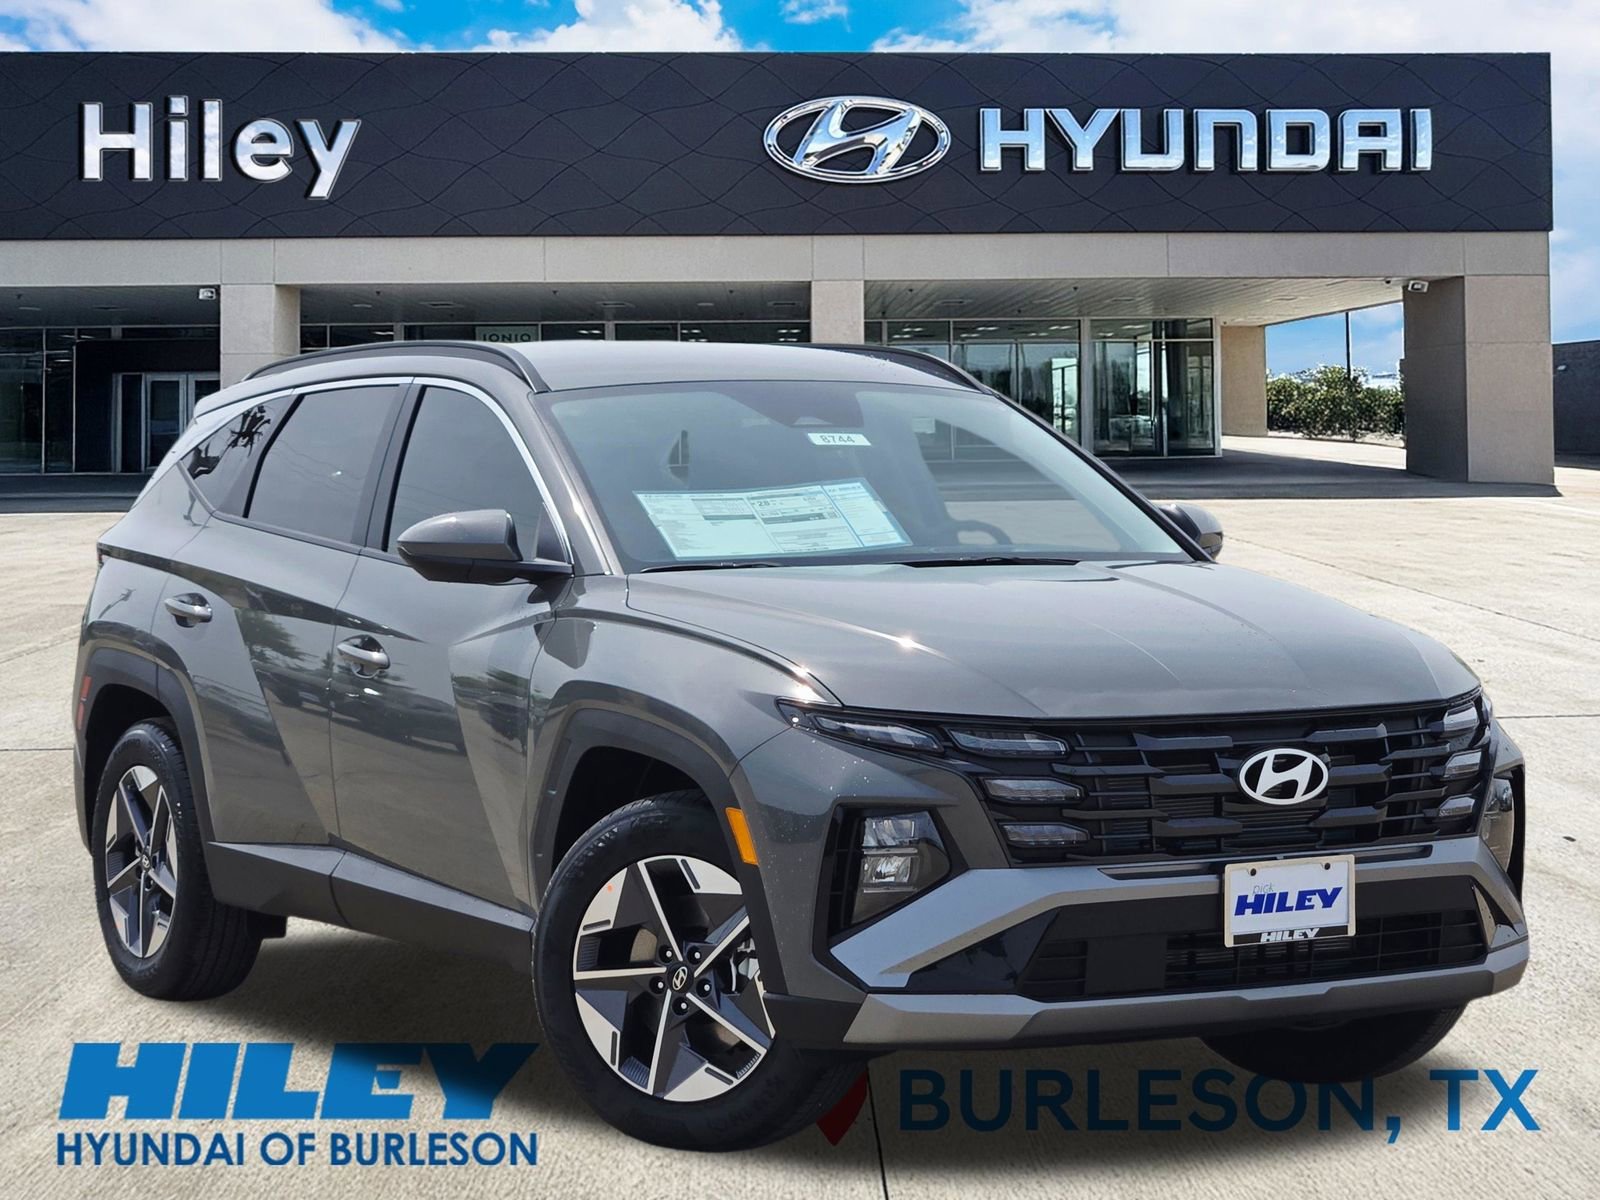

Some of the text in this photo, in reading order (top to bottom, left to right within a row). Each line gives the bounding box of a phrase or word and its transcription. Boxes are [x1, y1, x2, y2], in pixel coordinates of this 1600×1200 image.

[80, 96, 361, 199] Hiley
[980, 107, 1433, 172] HYUNDAI
[819, 435, 855, 443] 8744
[1235, 887, 1342, 916] HILEY
[1260, 929, 1319, 943] HILEY
